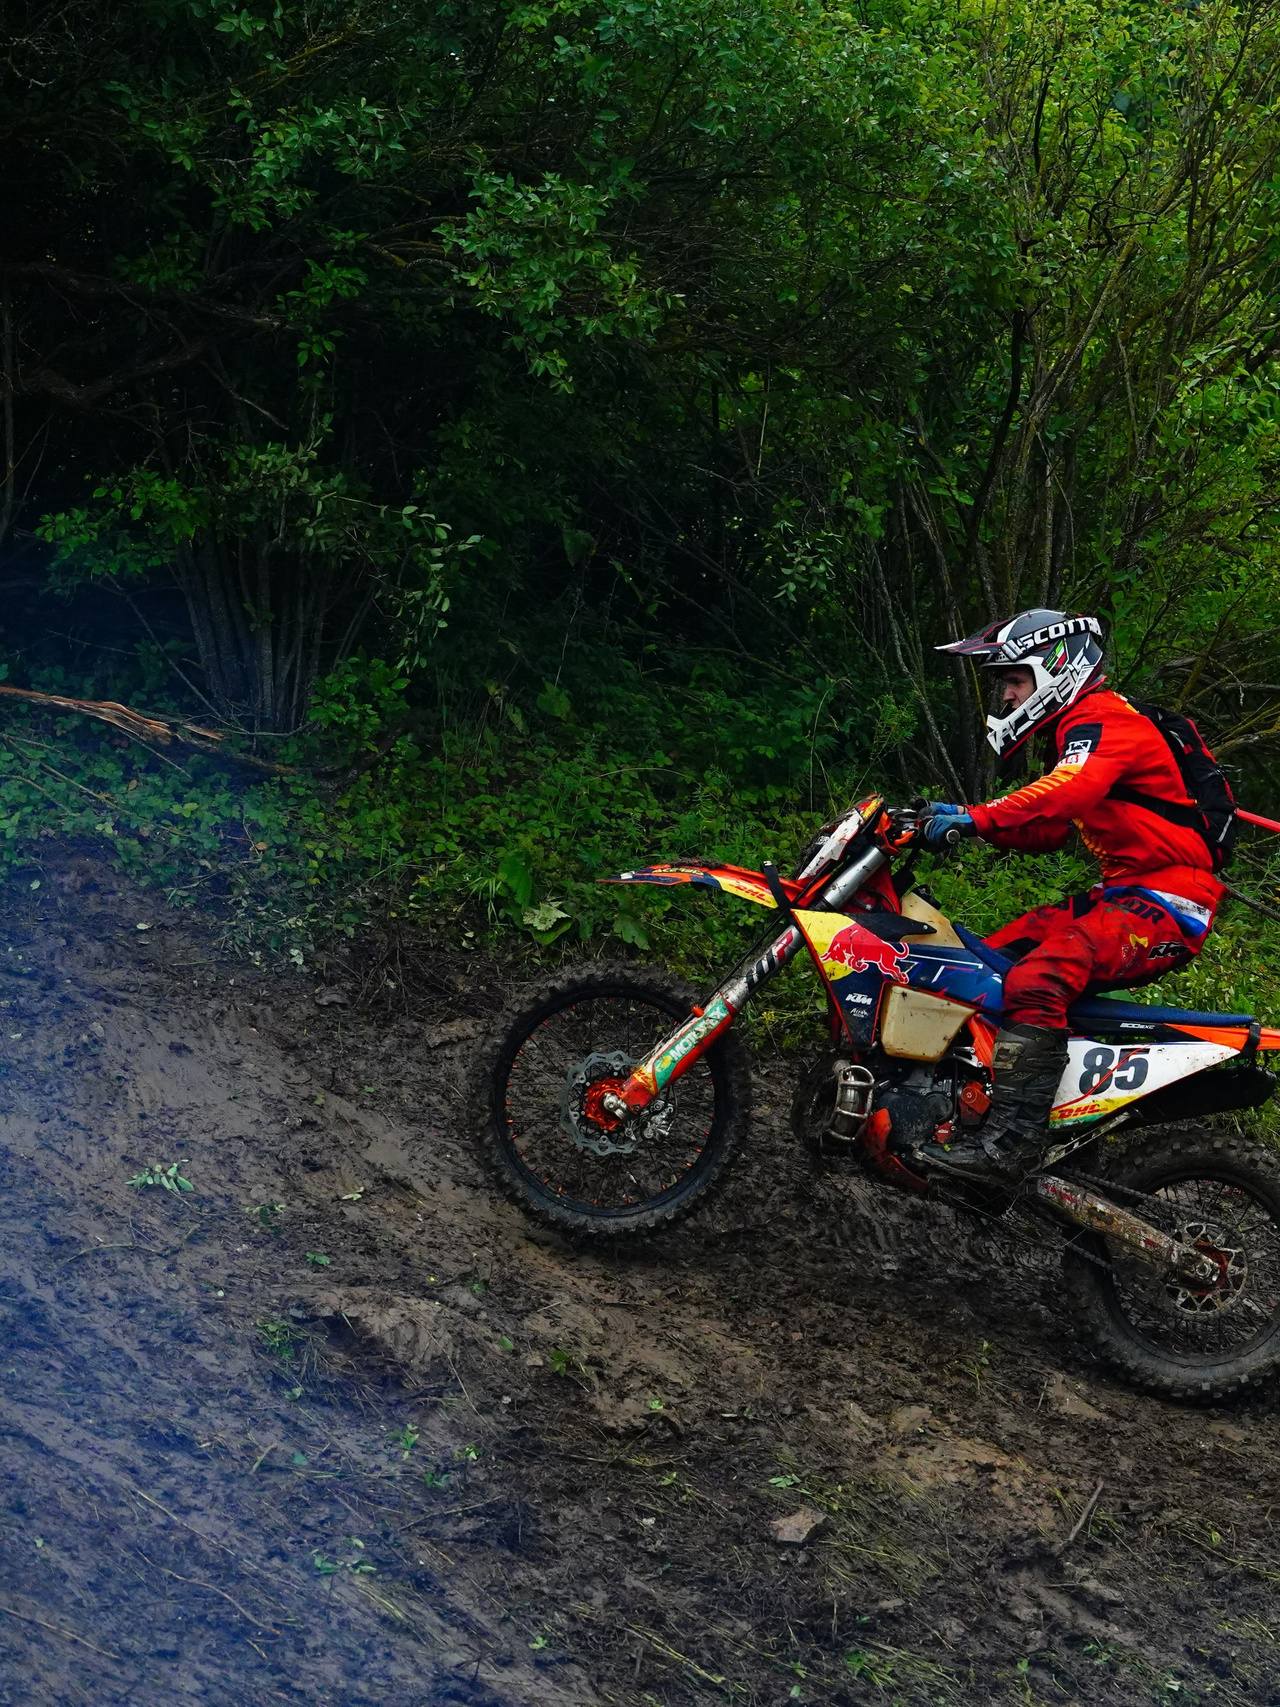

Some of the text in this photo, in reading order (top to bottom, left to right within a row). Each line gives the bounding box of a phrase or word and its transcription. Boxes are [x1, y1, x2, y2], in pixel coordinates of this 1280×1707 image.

[1016, 617, 1091, 651] SCOTT
[735, 885, 765, 901] DHL
[845, 992, 873, 1005] KTM
[1079, 1047, 1149, 1095] 85
[1058, 1104, 1101, 1119] DHL
